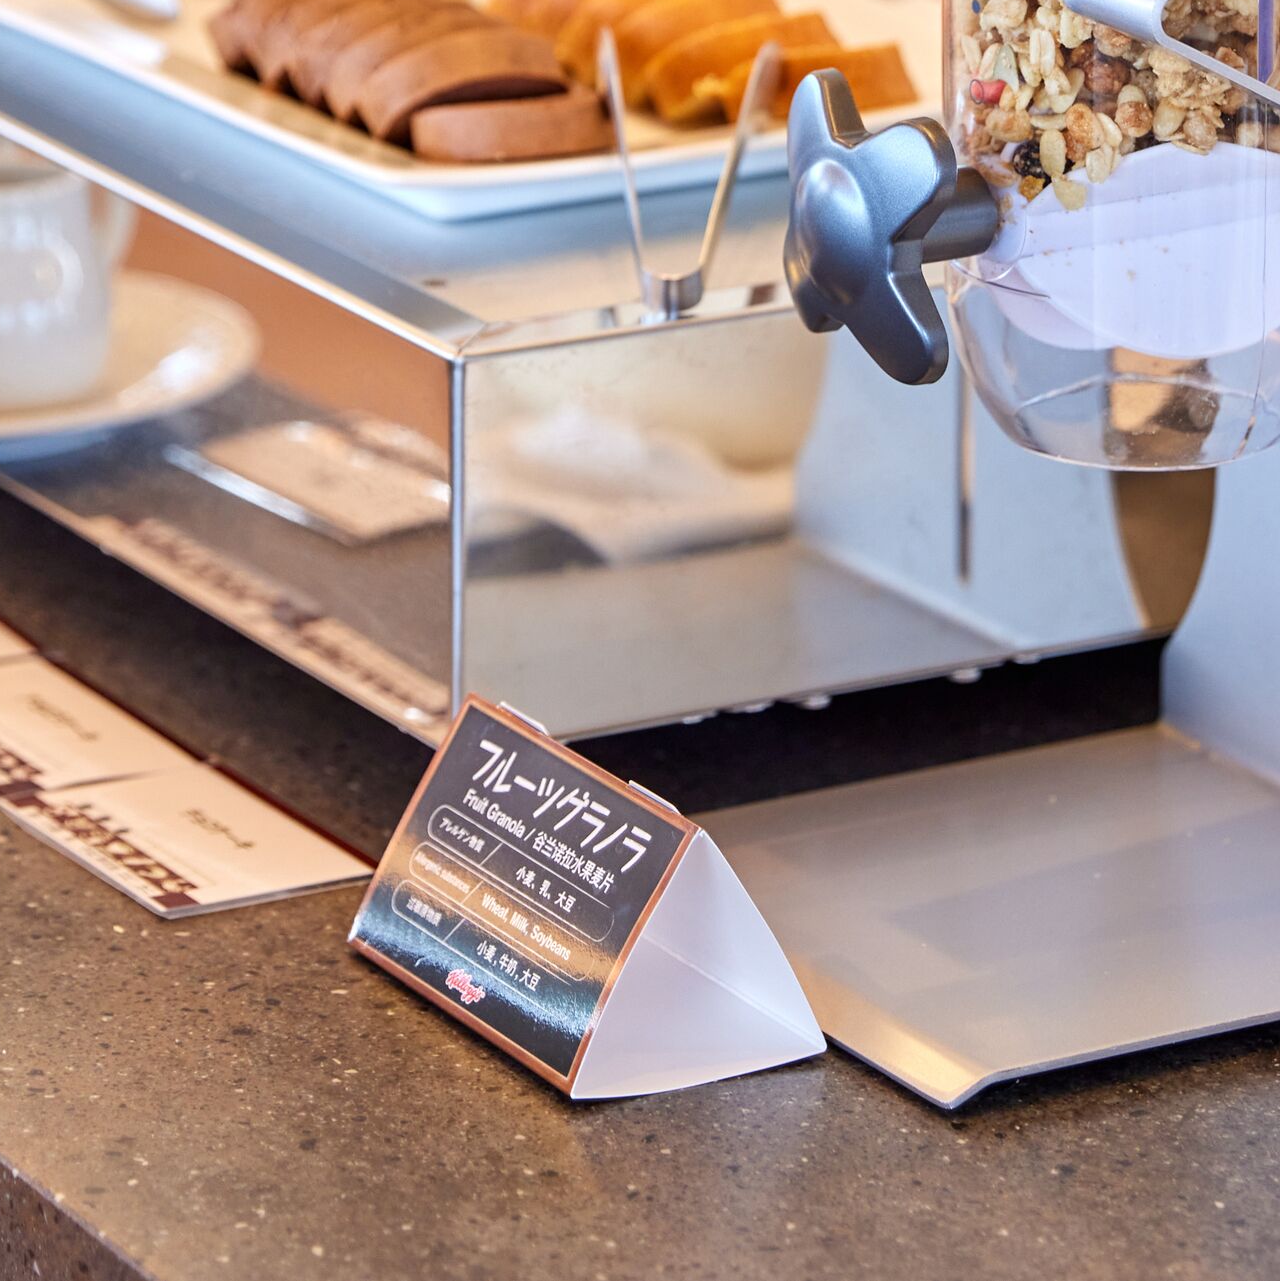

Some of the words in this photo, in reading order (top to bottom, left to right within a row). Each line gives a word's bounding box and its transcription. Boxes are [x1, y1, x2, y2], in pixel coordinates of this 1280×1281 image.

[463, 788, 489, 815] Fruit
[486, 803, 526, 838] Granola
[532, 831, 615, 894] 谷兰诺拉水果麦片
[472, 739, 652, 873] フルーツグラノラ
[482, 893, 509, 923] Wheat,
[510, 911, 530, 936] Milk,
[530, 925, 571, 961] Soybeans
